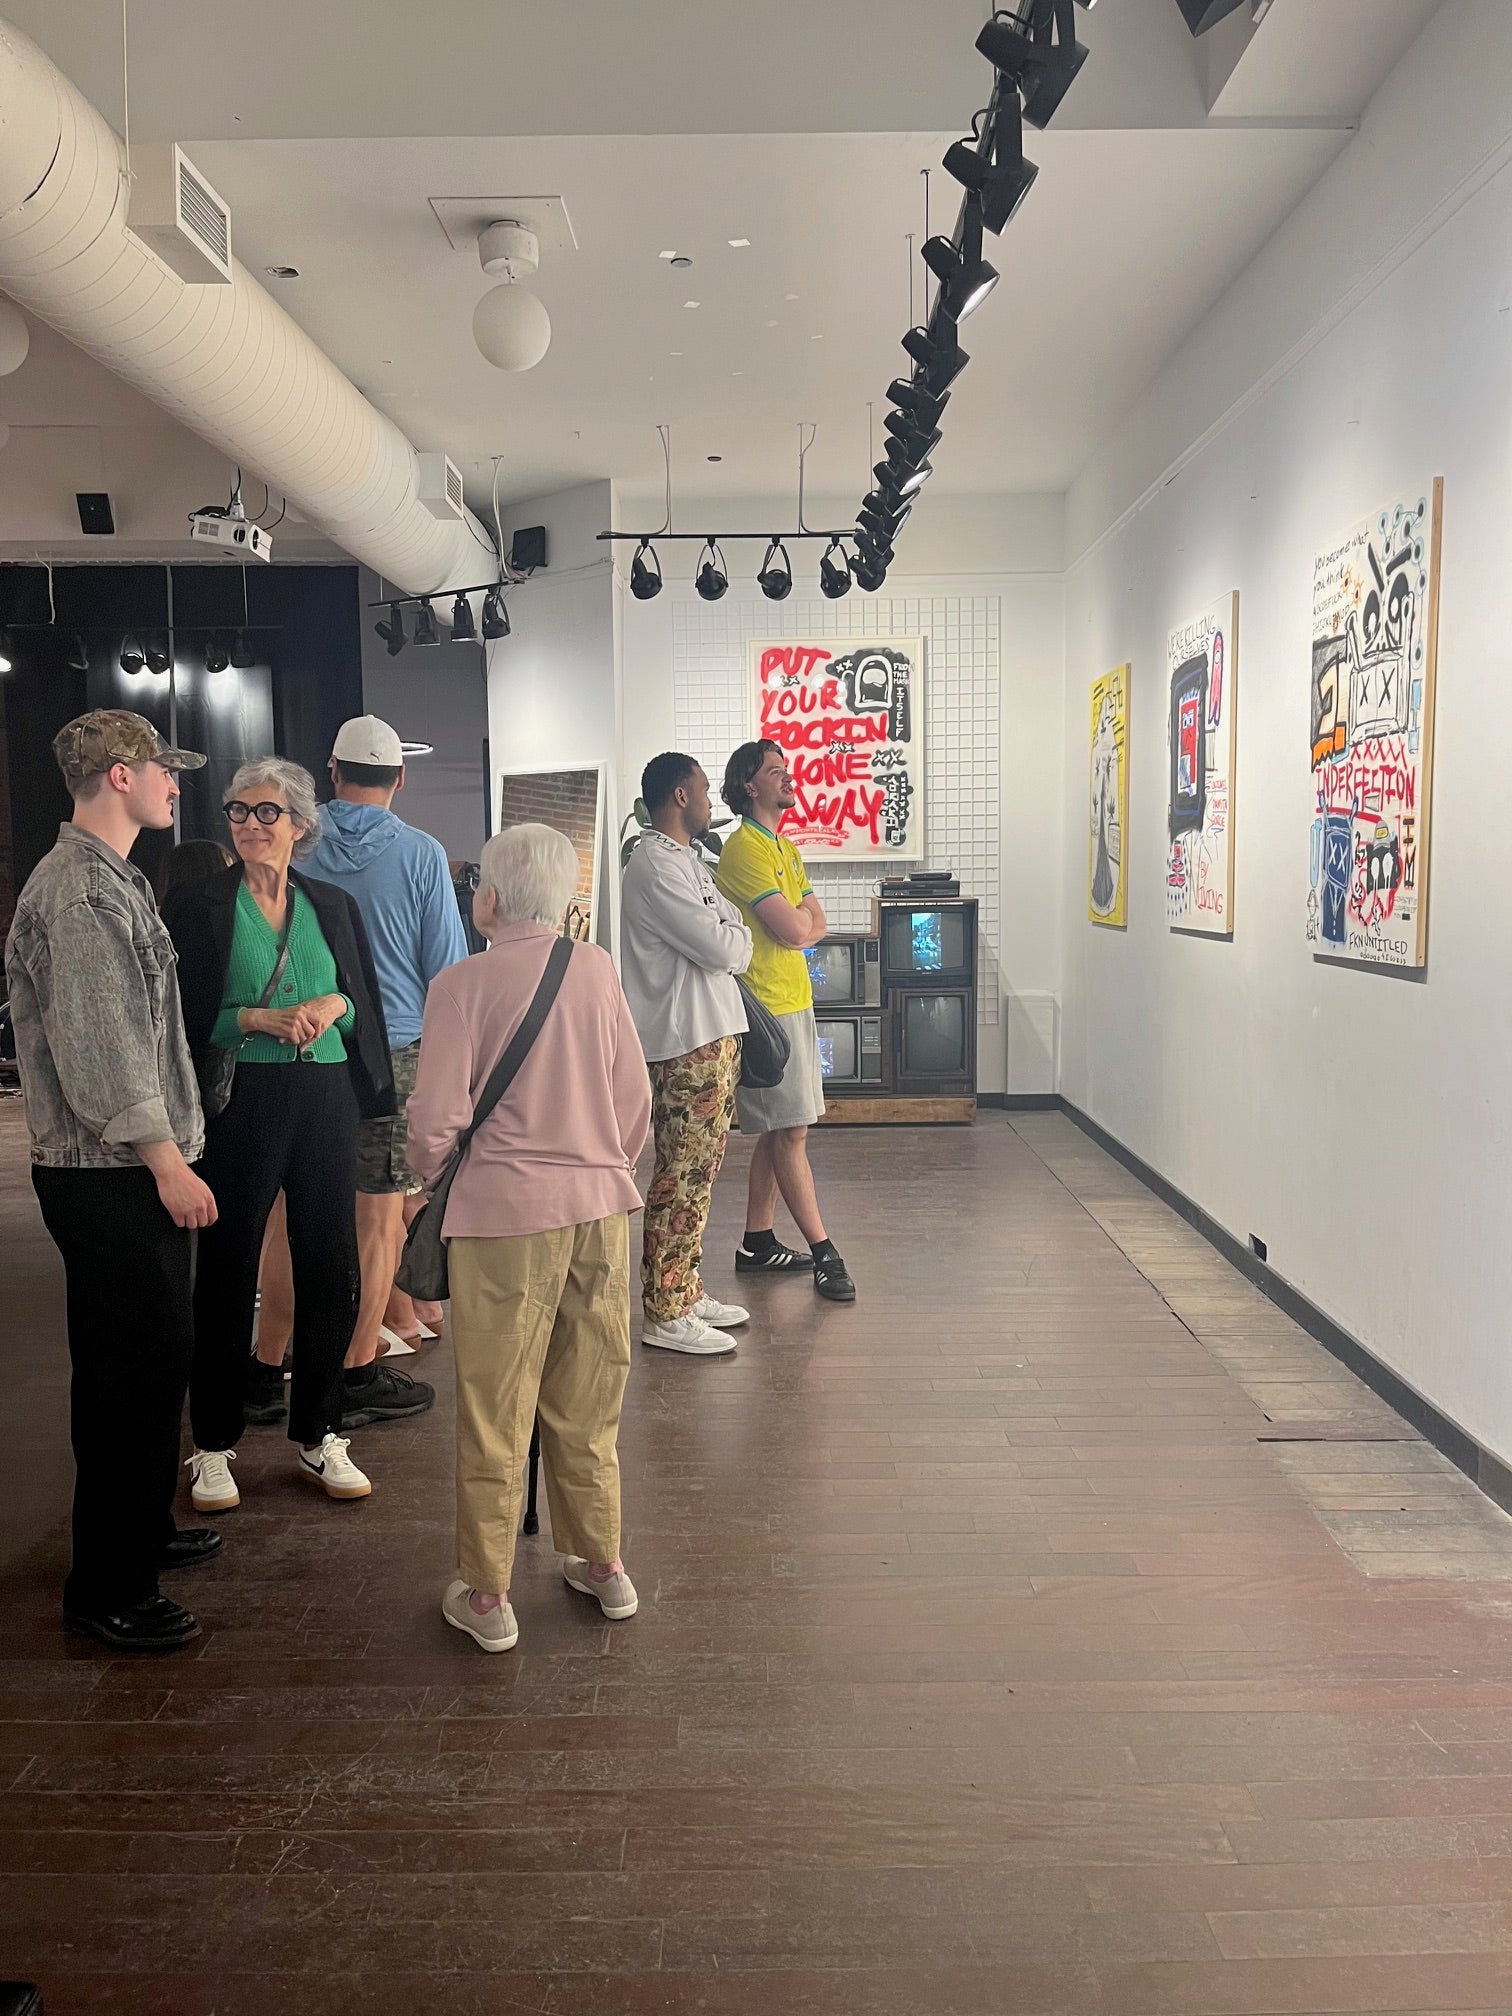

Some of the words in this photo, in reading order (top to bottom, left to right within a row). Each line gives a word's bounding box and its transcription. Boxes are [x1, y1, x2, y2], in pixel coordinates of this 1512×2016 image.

[761, 646, 832, 684] PUT
[760, 679, 842, 723] YOUR
[896, 687, 905, 738] ITSELF
[785, 752, 873, 788] HONE
[777, 785, 886, 844] AWAY
[1363, 934, 1408, 955] UNTITLED
